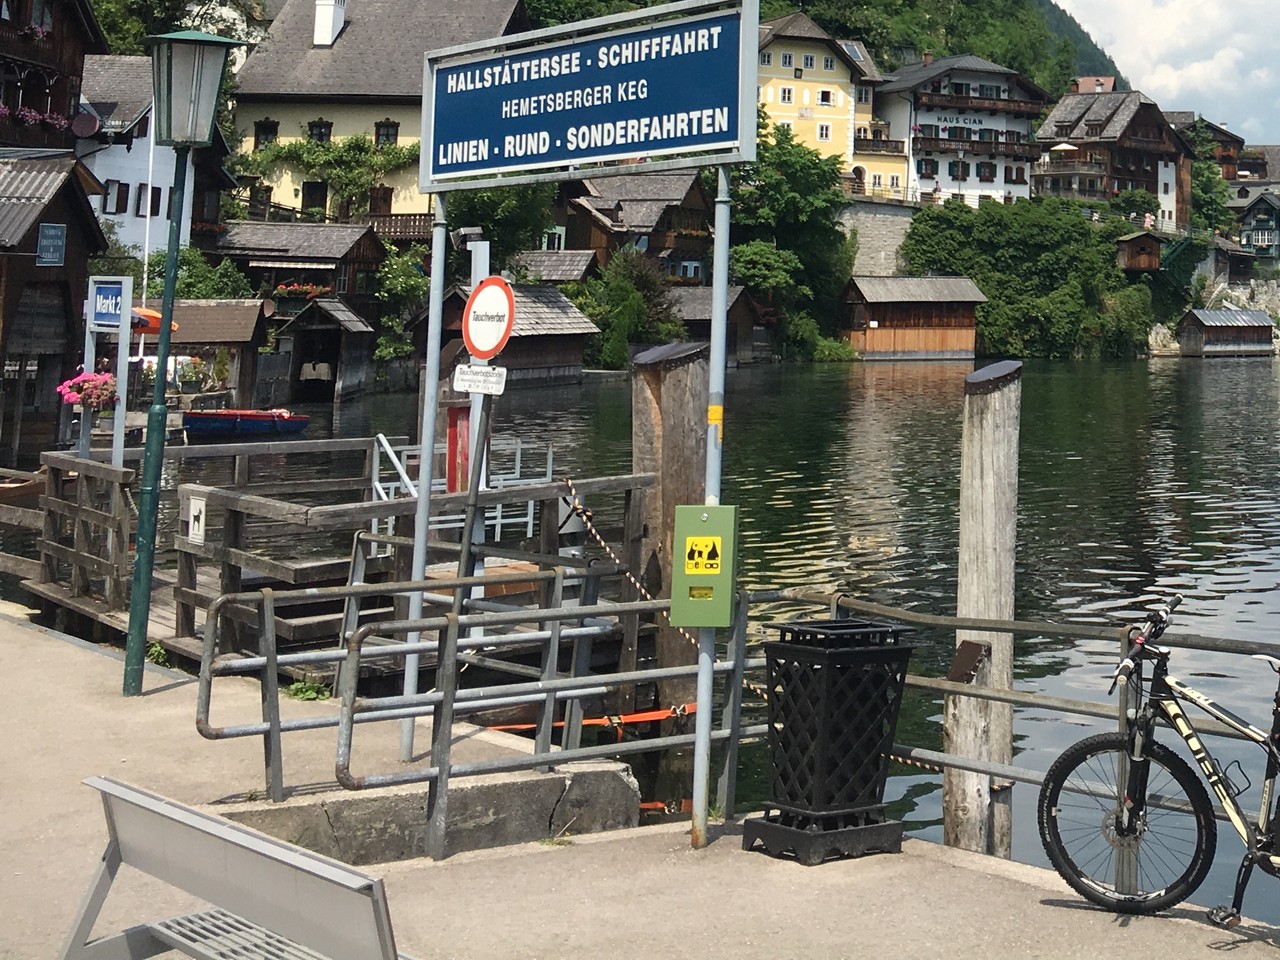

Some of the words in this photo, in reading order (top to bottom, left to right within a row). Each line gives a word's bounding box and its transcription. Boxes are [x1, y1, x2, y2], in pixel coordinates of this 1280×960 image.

[447, 51, 581, 94] HALLSTÄTTERSEE
[598, 25, 722, 68] SCHIFFFAHRT
[501, 84, 612, 119] HEMETSBERGER
[617, 79, 648, 102] KEG
[937, 116, 960, 124] HAUS
[963, 117, 983, 126] CIAN
[438, 138, 489, 166] LINIEN
[504, 130, 550, 158] RUND
[566, 107, 729, 152] SONDERFAHRTEN
[95, 294, 115, 313] Markt
[472, 310, 506, 323] Tauchverbot
